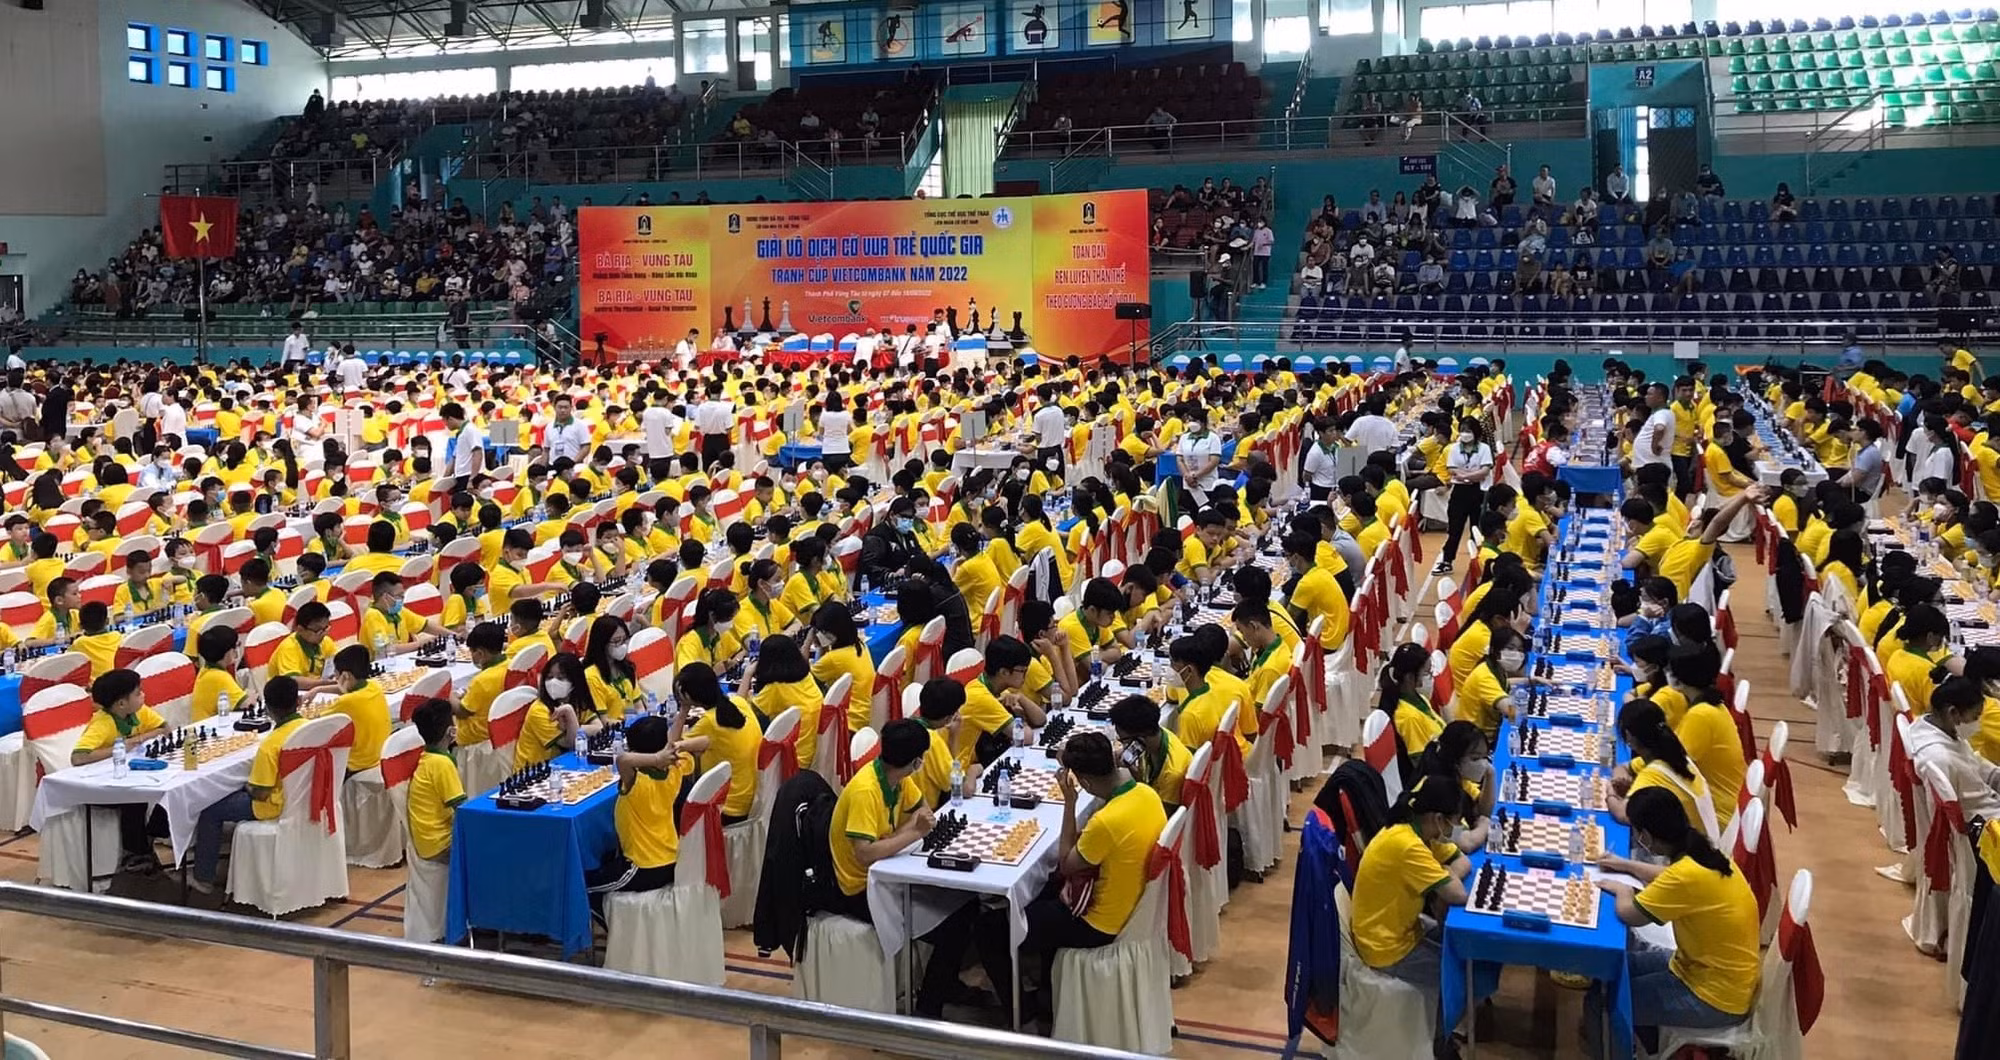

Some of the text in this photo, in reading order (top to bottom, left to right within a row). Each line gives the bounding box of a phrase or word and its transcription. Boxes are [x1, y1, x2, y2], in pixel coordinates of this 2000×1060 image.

[1639, 70, 1652, 80] A2
[757, 233, 782, 258] GIẢI
[786, 236, 803, 257] VÔ
[893, 231, 917, 256] TRẺ
[919, 230, 956, 258] QUỐC
[959, 235, 983, 256] GIA
[772, 268, 804, 284] TRANH
[831, 266, 906, 283] VIETCOMBANK
[939, 266, 968, 282] 2022
[597, 290, 613, 304] BA
[615, 290, 633, 304] RIA
[644, 289, 672, 303] VUNG
[675, 288, 693, 302] TAU
[808, 313, 866, 324] Vietcombank
